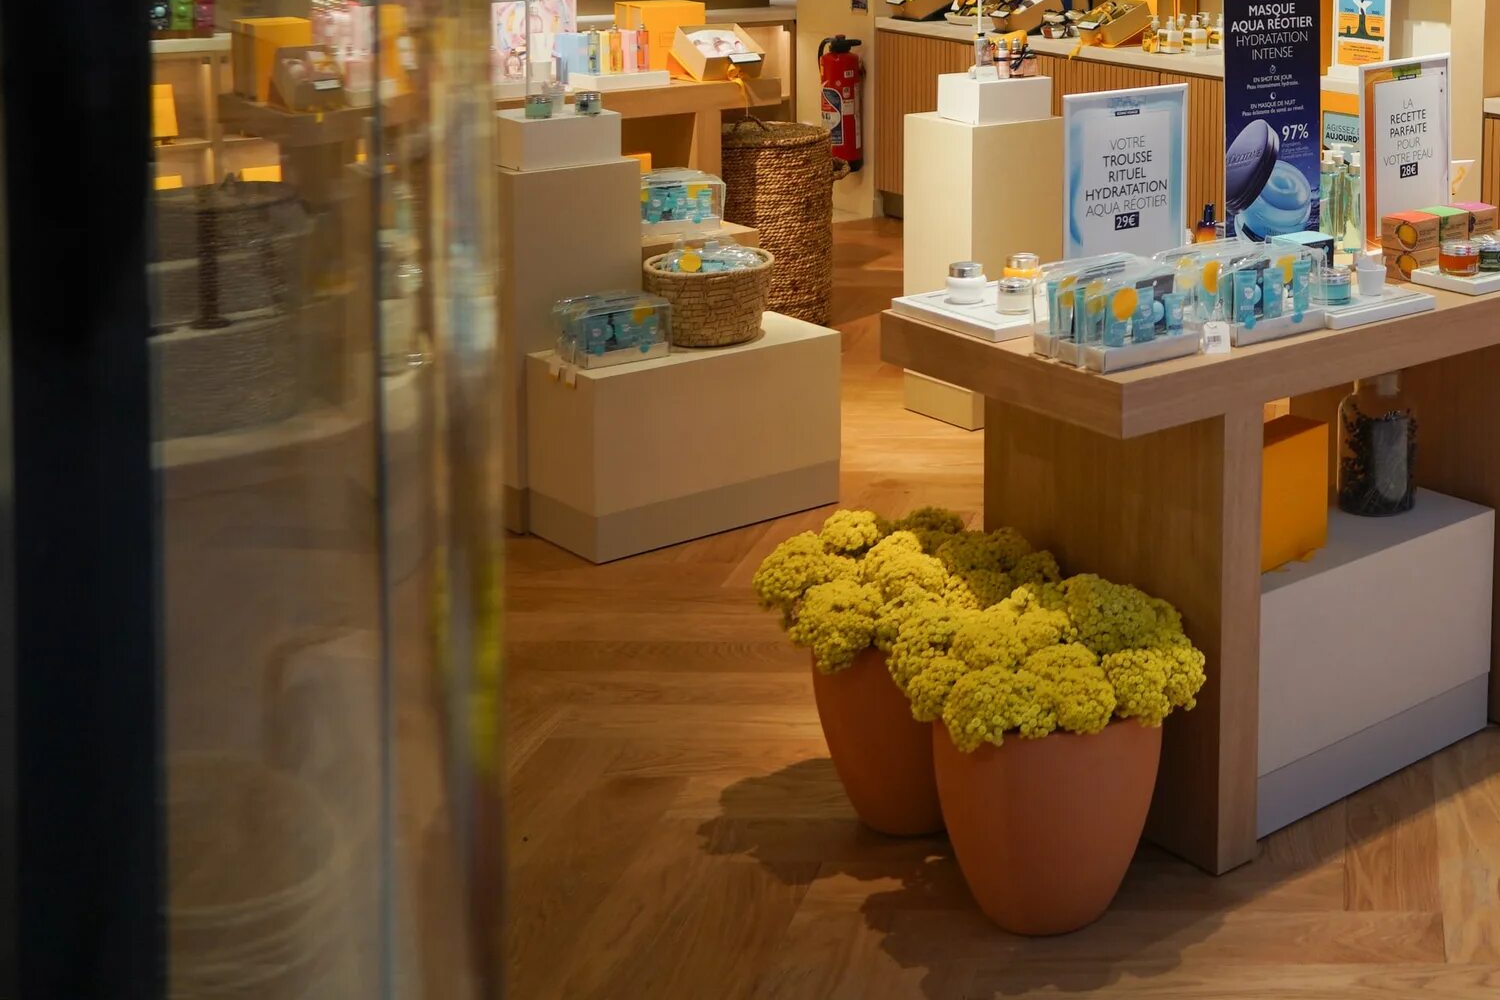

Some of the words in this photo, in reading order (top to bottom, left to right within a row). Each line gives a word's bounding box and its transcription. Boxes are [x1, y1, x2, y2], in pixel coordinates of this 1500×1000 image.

[1248, 3, 1295, 18] MASQUE
[1231, 19, 1265, 34] AQUA
[1267, 15, 1313, 30] RÉOTIER
[1236, 31, 1308, 47] HYDRATATION
[1252, 46, 1294, 60] INTENSE
[1280, 74, 1293, 82] JOUR
[1258, 101, 1276, 109] MASQUE
[1403, 98, 1414, 109] LA
[1390, 109, 1426, 125] RECETTE
[1282, 123, 1309, 141] 97%
[1327, 124, 1355, 134] AGISSEZ
[1390, 122, 1427, 138] PARFAITE
[1110, 135, 1145, 151] VOTRE
[1397, 137, 1421, 150] POUR
[1103, 150, 1152, 167] TROUSSE
[1384, 152, 1410, 166] VOTRE
[1412, 147, 1433, 161] PEAU
[1108, 167, 1146, 182] RITUEL
[1401, 164, 1417, 177] 28€
[1085, 179, 1168, 201] HYDRATATION
[1086, 202, 1121, 218] AQUA
[1123, 194, 1167, 210] RÉOTIER
[1116, 214, 1137, 229] 29€
